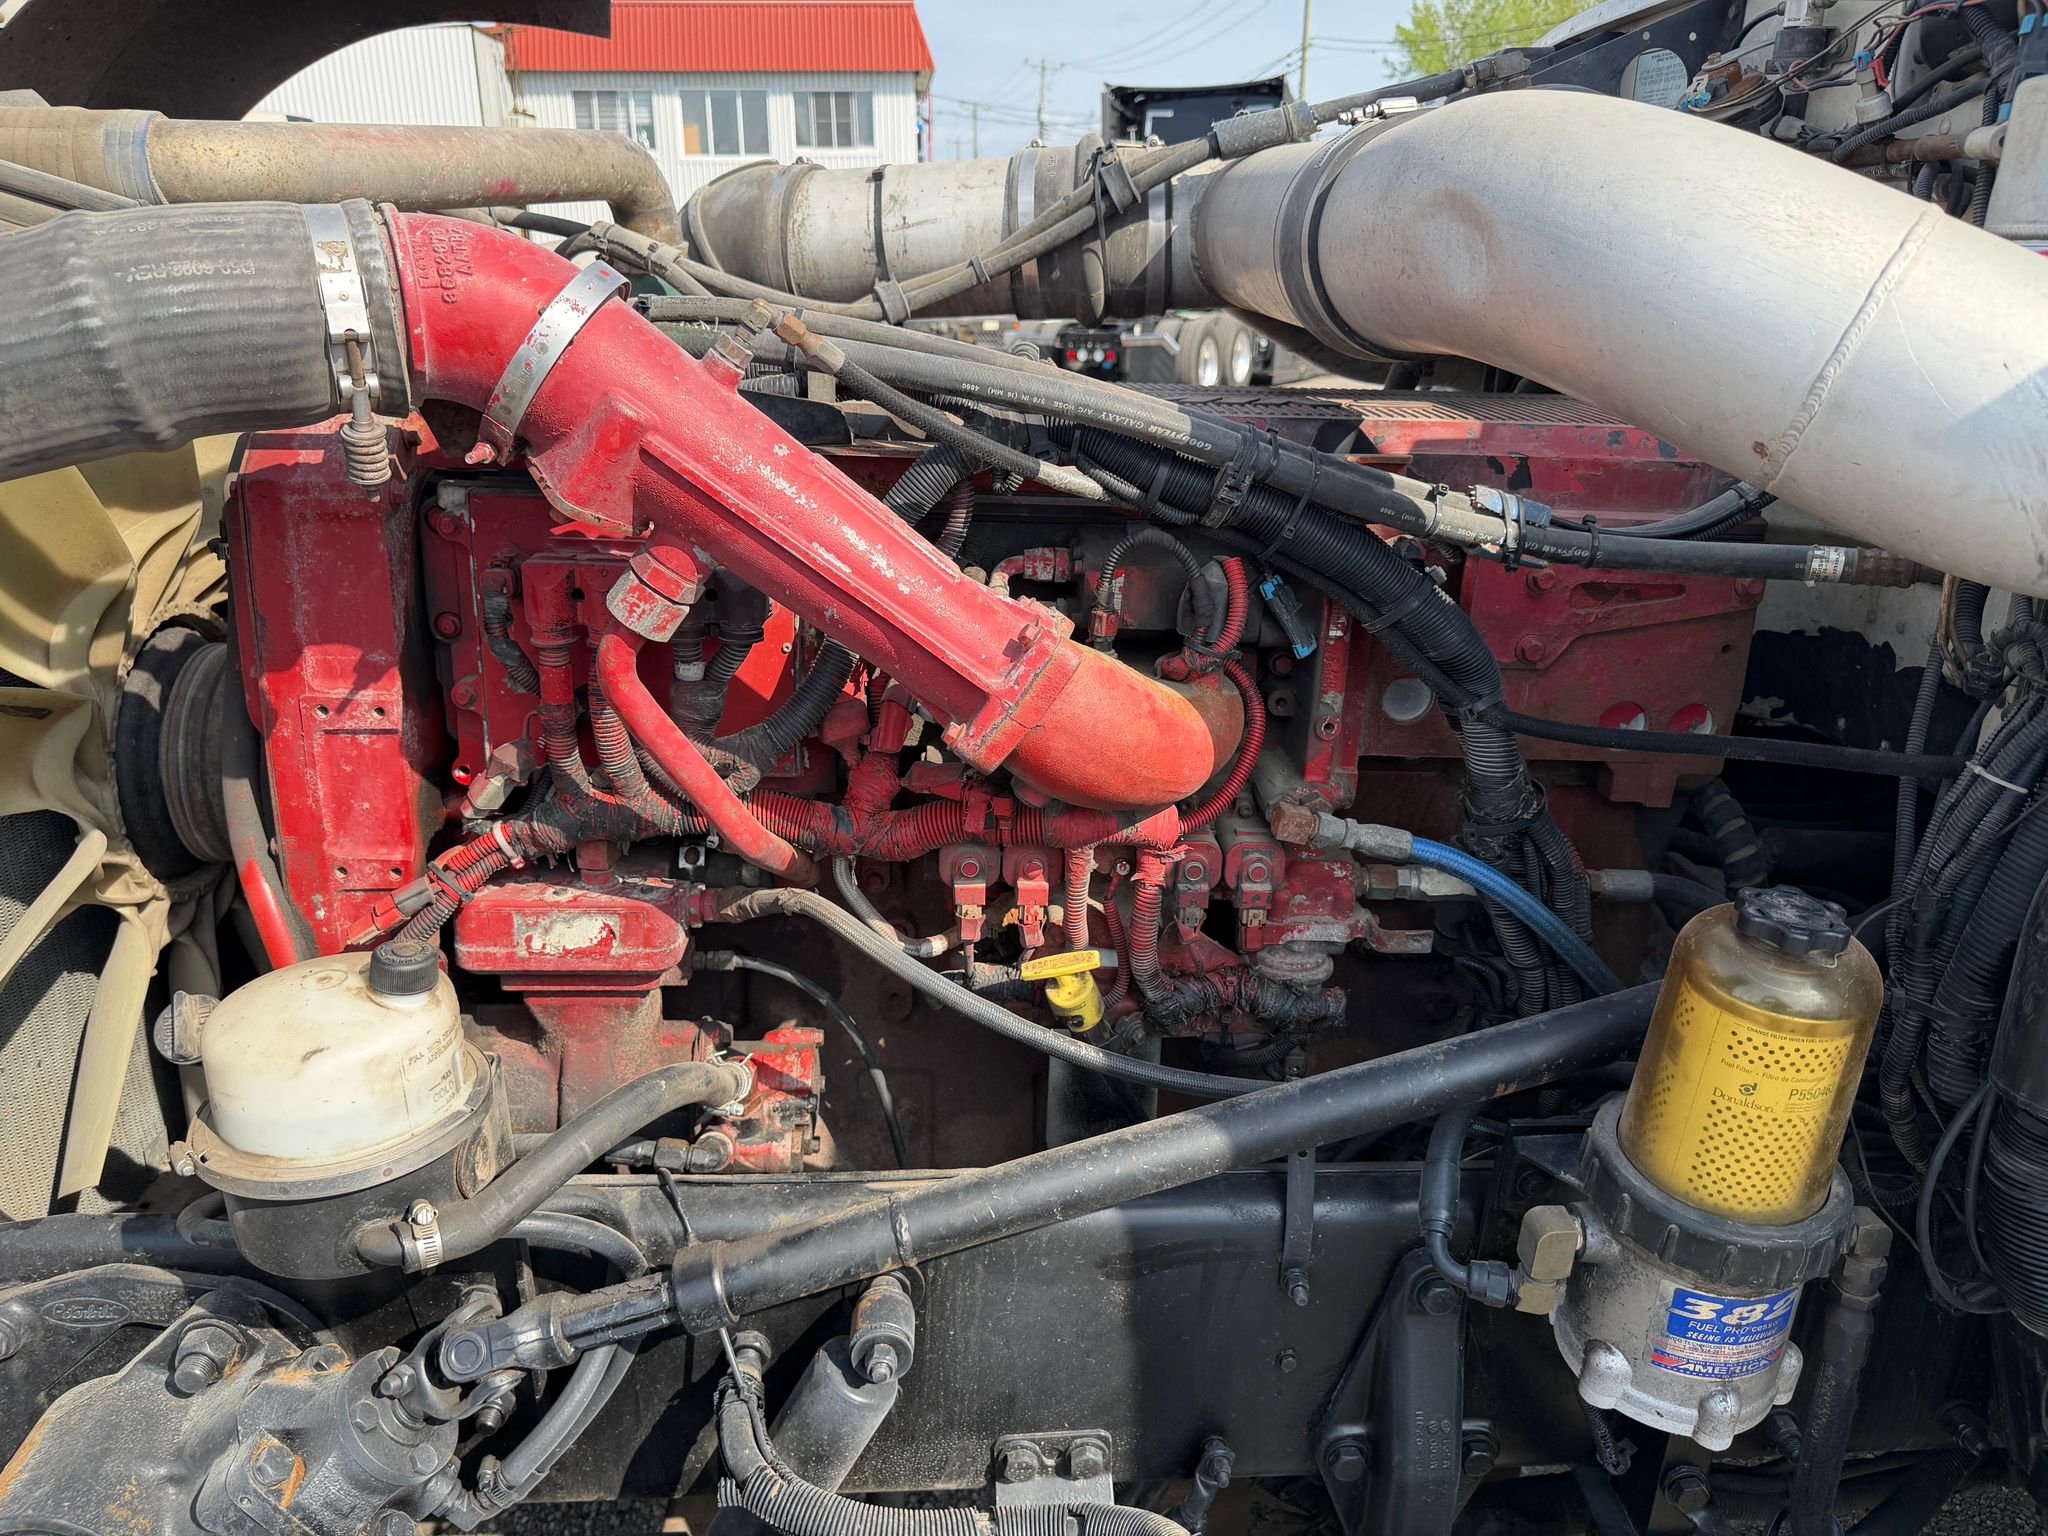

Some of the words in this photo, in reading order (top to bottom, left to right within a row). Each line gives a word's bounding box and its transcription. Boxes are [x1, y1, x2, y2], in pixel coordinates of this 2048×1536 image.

[987, 386, 1004, 396] MM)
[1021, 394, 1030, 402] IN
[1052, 400, 1075, 411] HOSE
[1078, 406, 1093, 415] A/C
[1098, 411, 1145, 429] GALAXY
[1457, 528, 1477, 537] HOSE
[1479, 533, 1492, 541] A/C
[1746, 1025, 1769, 1037] CHANGE
[1770, 1032, 1788, 1041] FILTER
[1721, 1058, 1735, 1069] Fuel
[1735, 1064, 1753, 1075] Filter
[1762, 1071, 1780, 1081] Filtro
[1780, 1075, 1790, 1083] de
[1713, 1087, 1774, 1114] Donaldson
[1688, 1321, 1720, 1333] FUEL
[1686, 1331, 1722, 1343] SEEING
[1725, 1335, 1735, 1343] IS
[1683, 1339, 1728, 1351] TECHNOLOGY
[1677, 1357, 1773, 1375] AMERICA
[1689, 1358, 1706, 1366] WITH
